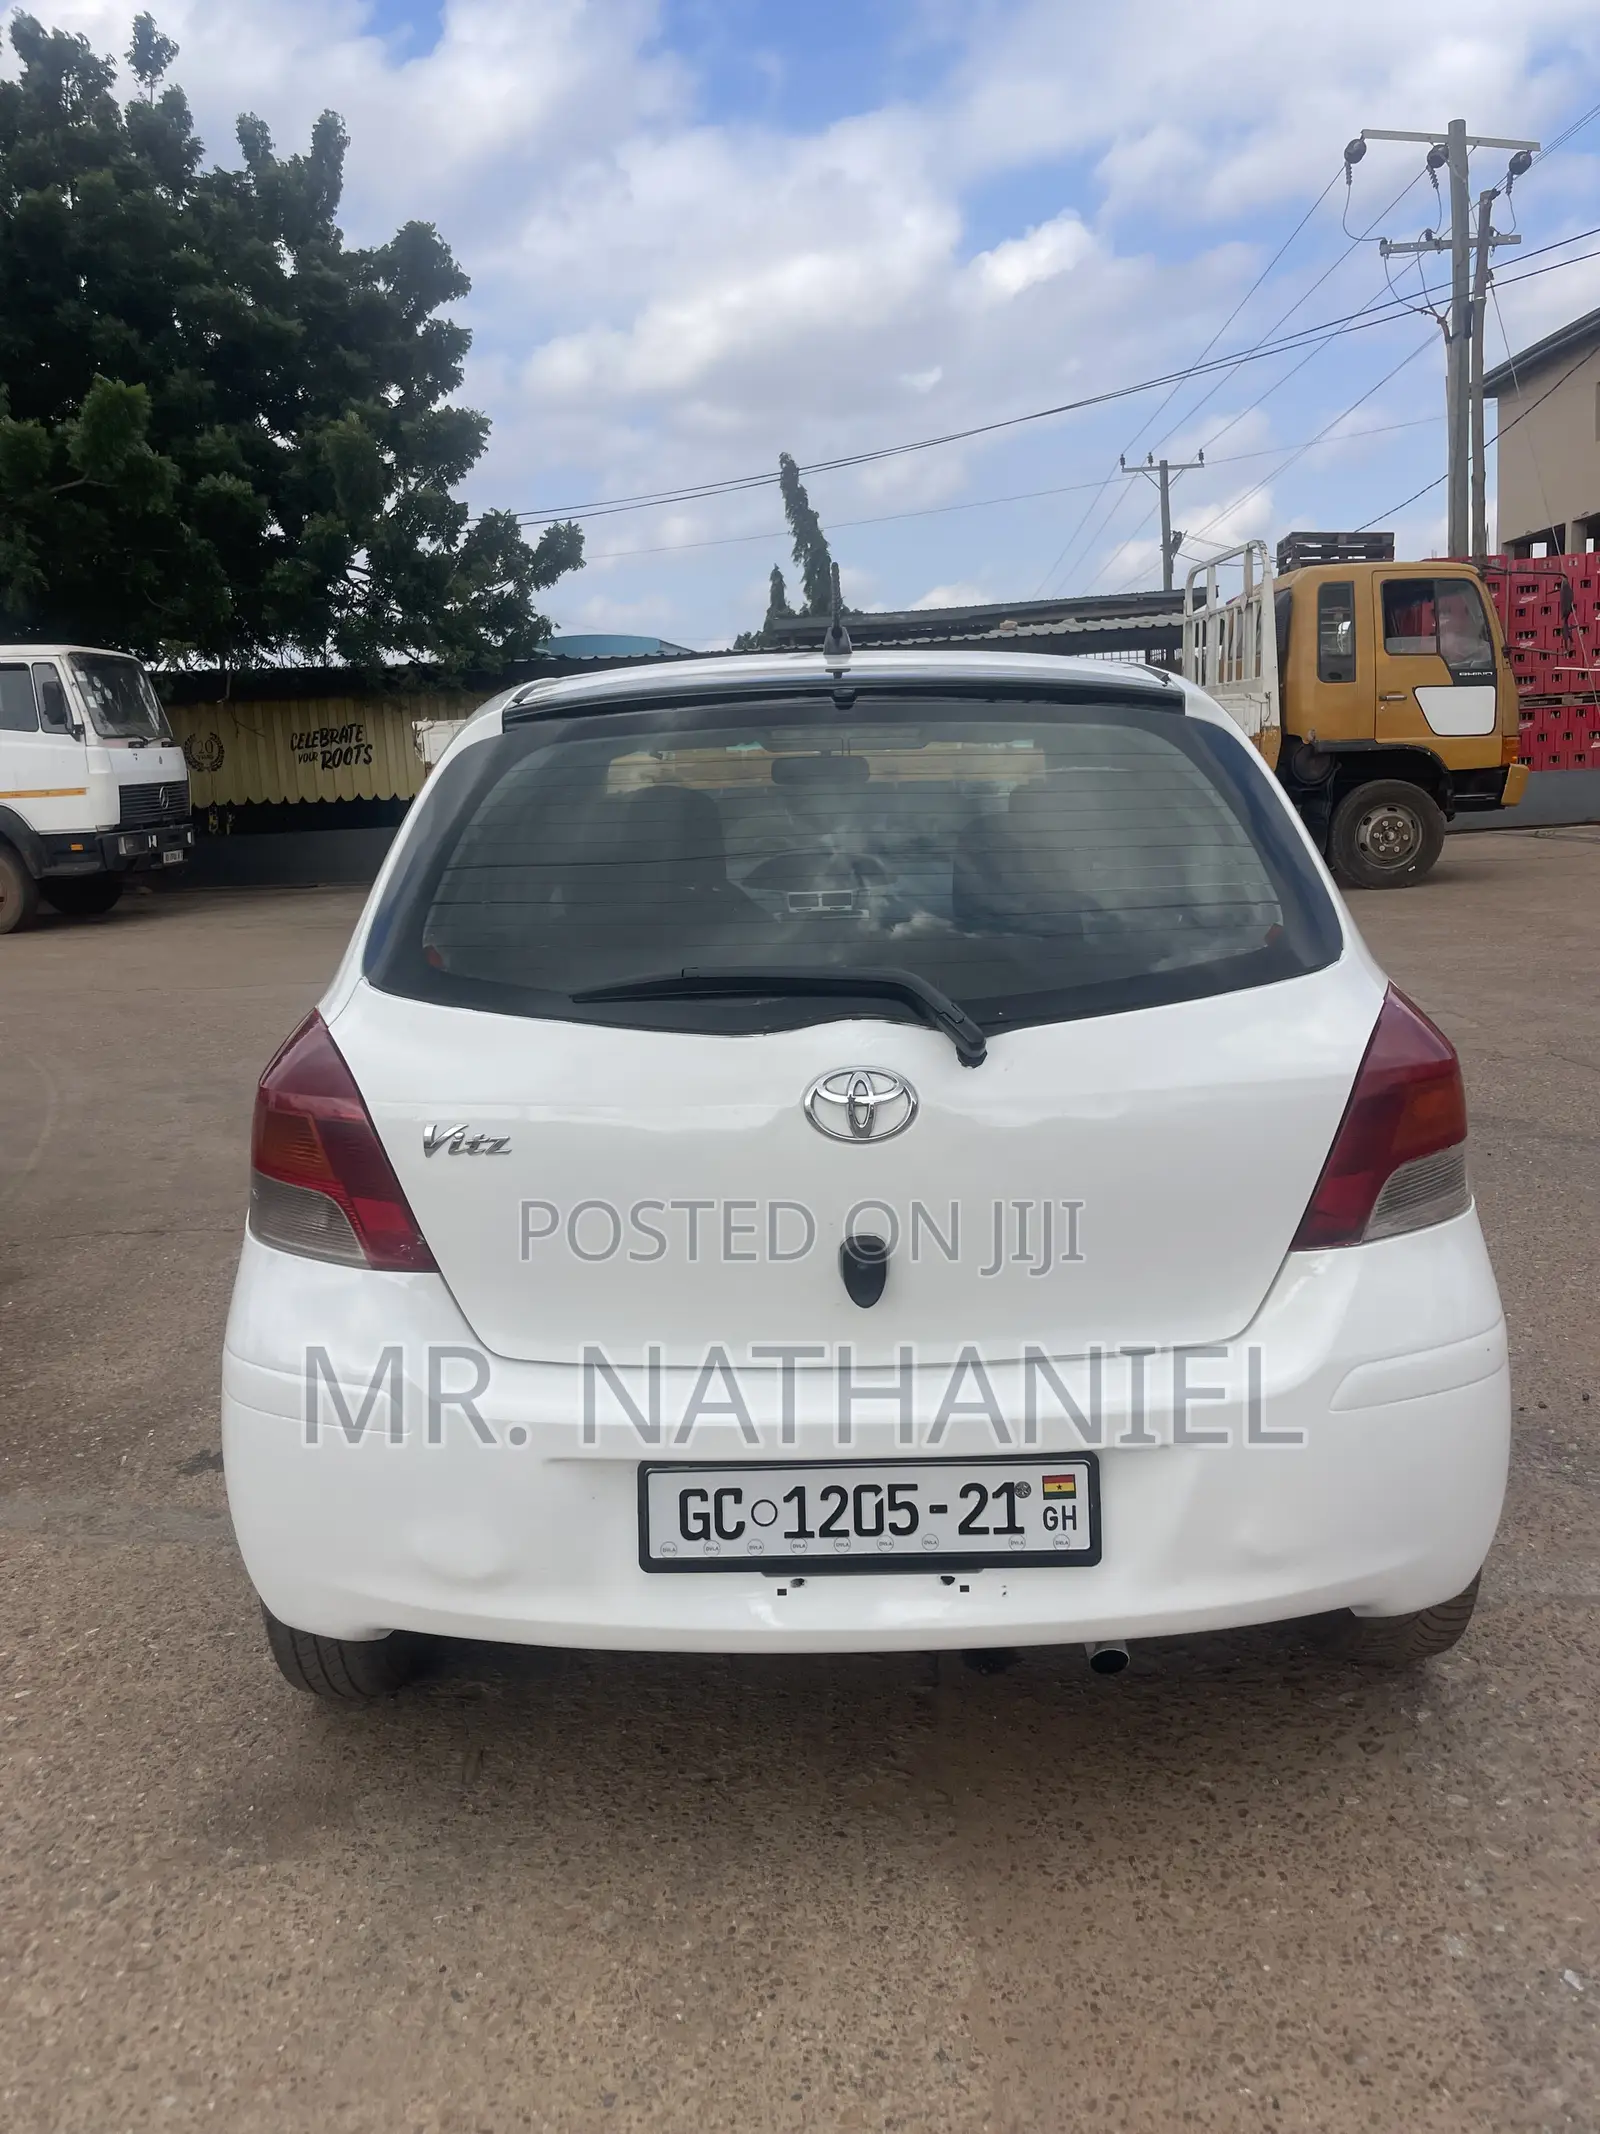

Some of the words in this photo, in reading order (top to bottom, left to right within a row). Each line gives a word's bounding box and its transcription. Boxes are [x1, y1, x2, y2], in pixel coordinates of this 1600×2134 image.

[196, 739, 214, 754] 20
[290, 723, 364, 751] CELEBRATE
[298, 751, 318, 765] YOUR
[320, 743, 373, 771] ROOTS
[423, 1123, 512, 1158] Vitz
[679, 1487, 746, 1541] GC
[1043, 1505, 1077, 1532] GH
